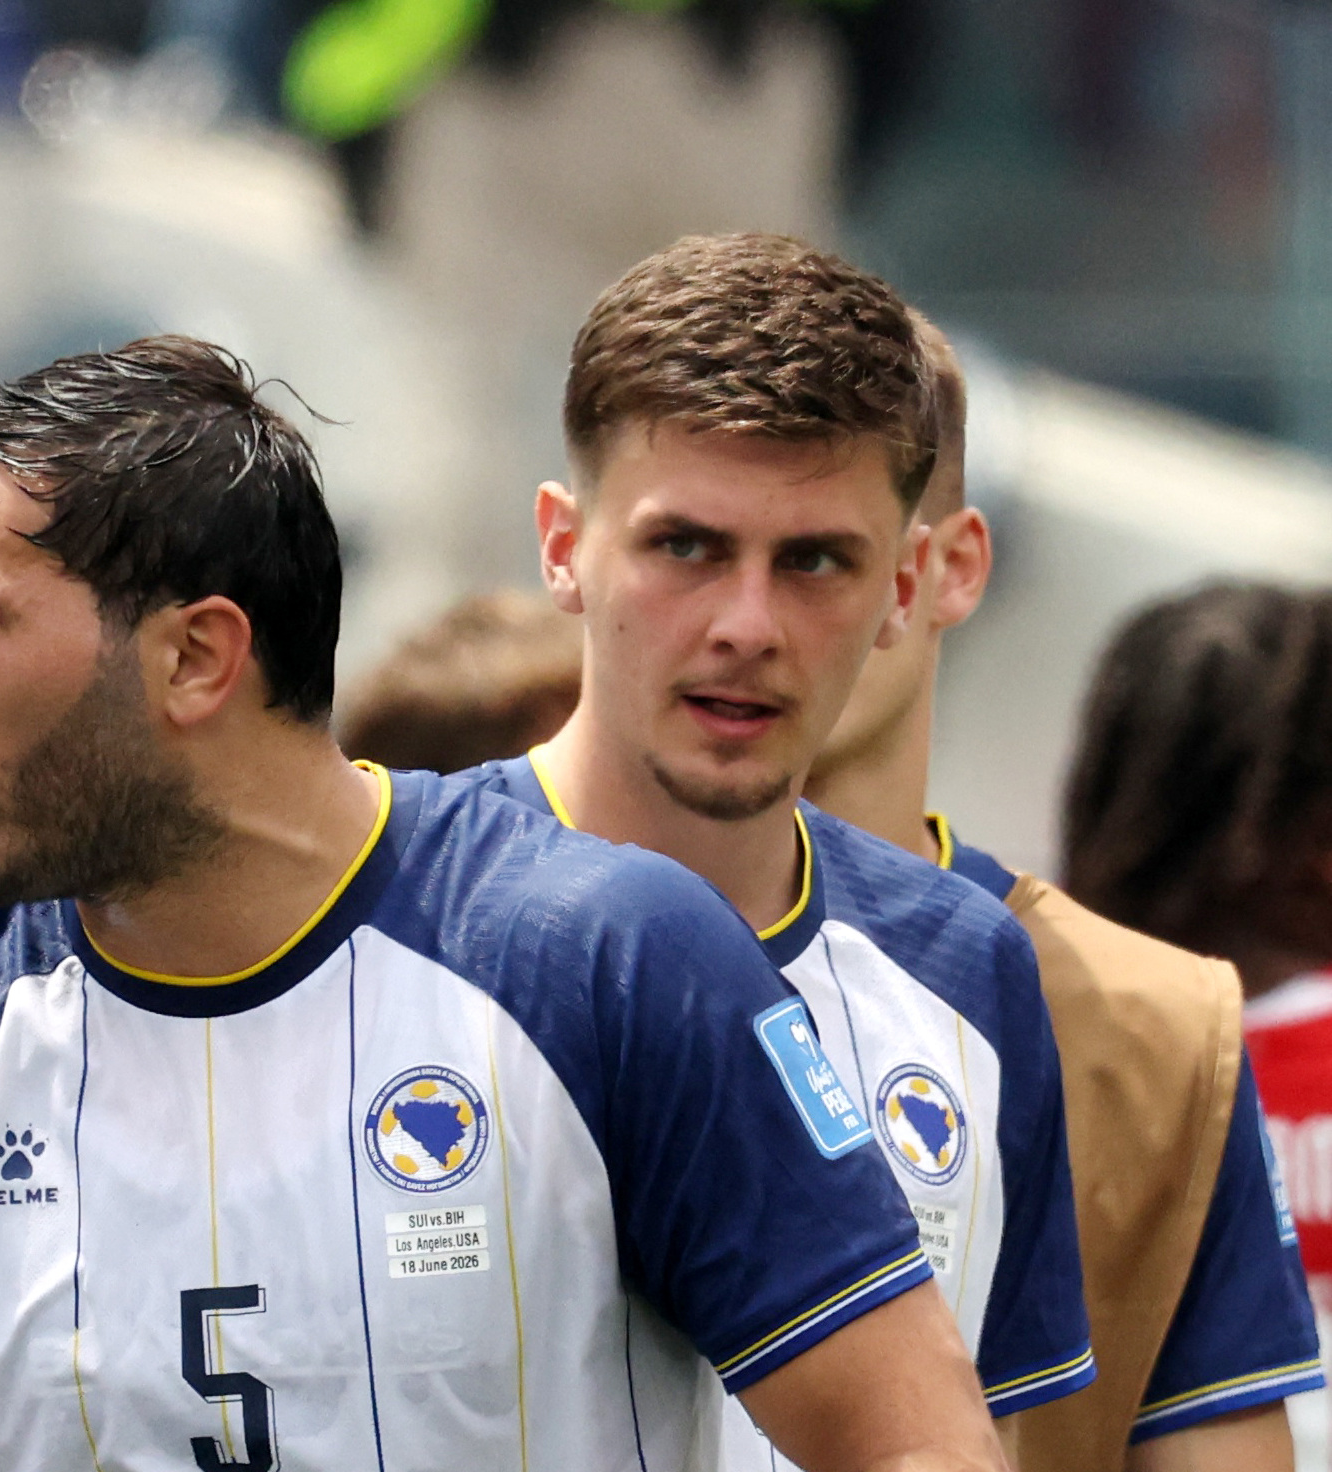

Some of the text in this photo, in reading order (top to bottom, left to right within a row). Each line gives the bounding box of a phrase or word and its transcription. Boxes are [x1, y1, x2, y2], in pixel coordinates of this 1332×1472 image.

[408, 1213, 428, 1229] SUI
[395, 1238, 412, 1252] Los
[401, 1255, 480, 1274] 18 June 2026
